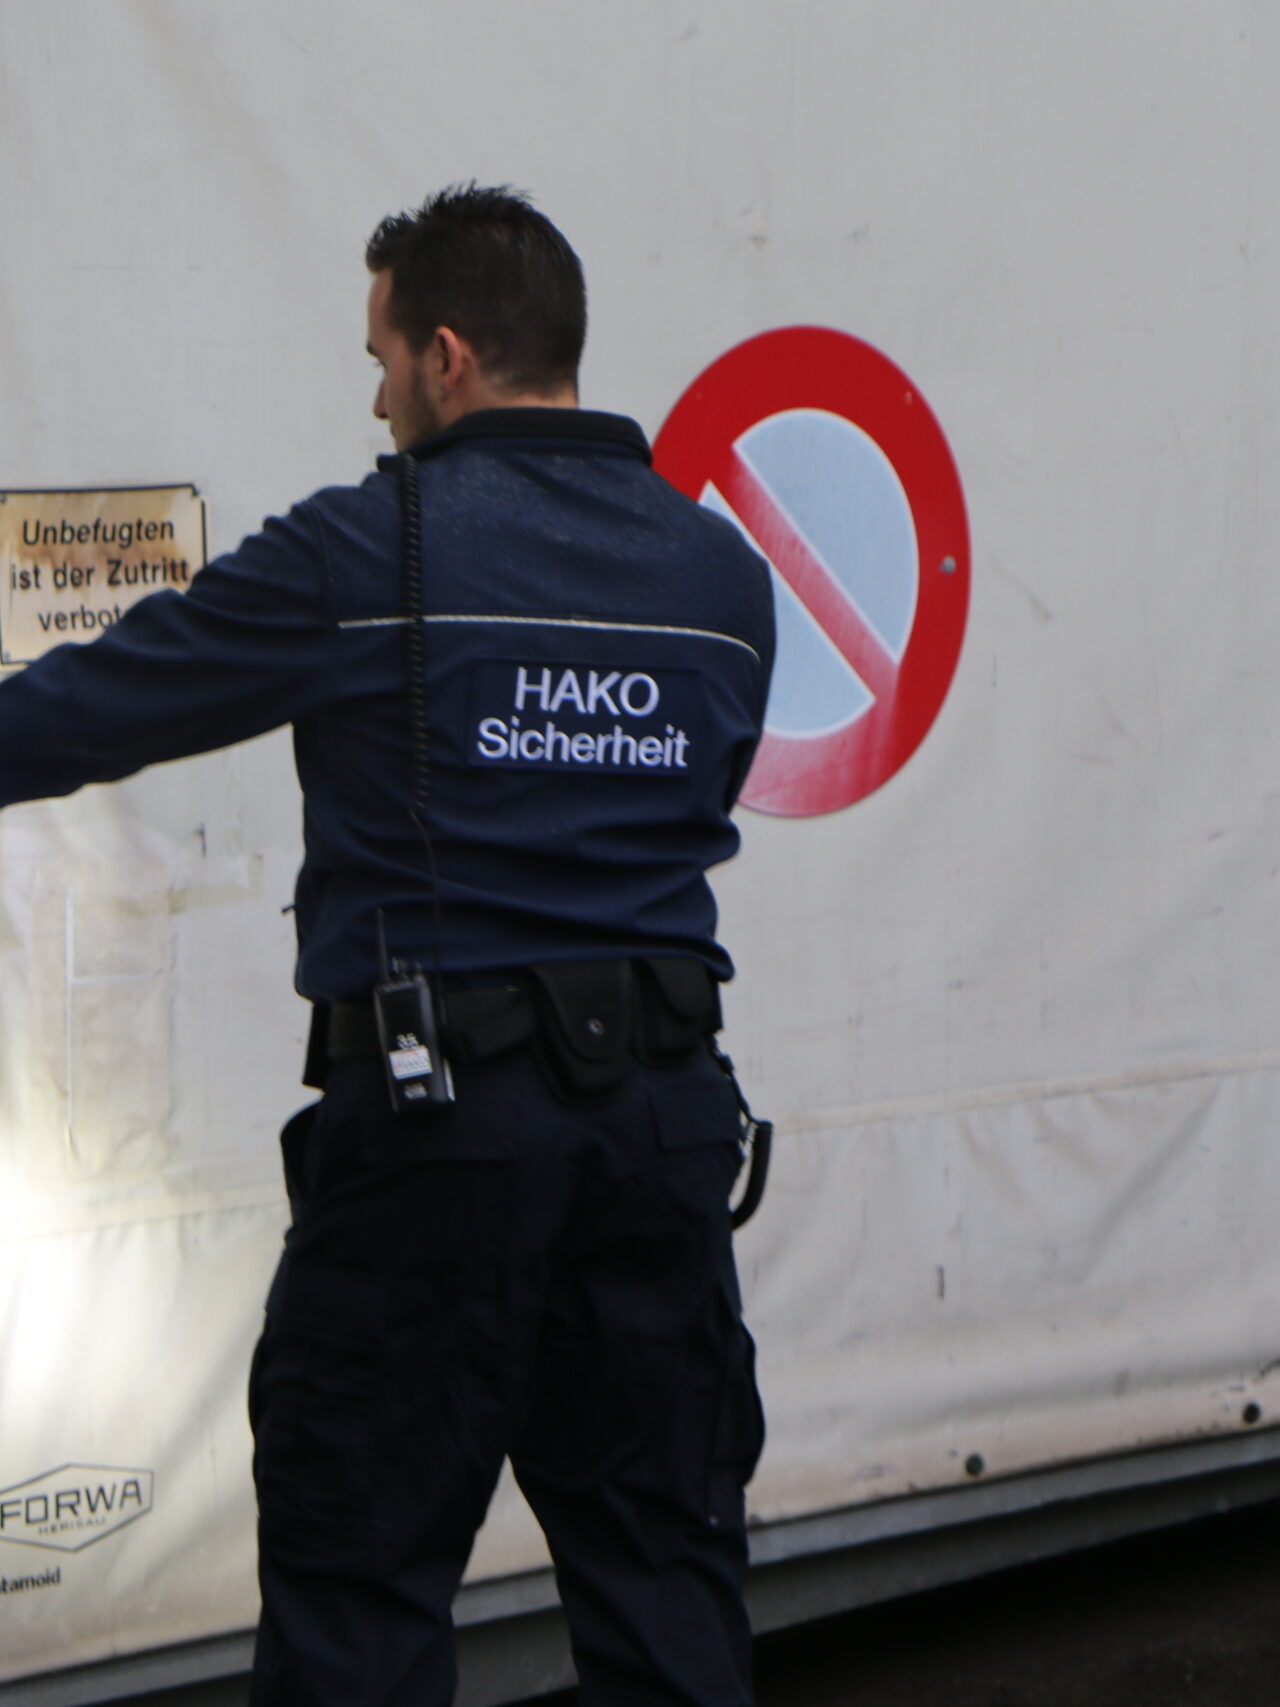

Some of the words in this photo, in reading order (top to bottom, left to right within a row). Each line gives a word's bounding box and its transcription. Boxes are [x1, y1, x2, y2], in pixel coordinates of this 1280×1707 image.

[23, 518, 174, 548] Unbefugten
[11, 564, 41, 589] ist
[53, 562, 95, 588] der
[107, 558, 189, 586] Zutritt
[38, 604, 121, 631] verbot
[514, 666, 660, 717] HAKO
[477, 715, 690, 768] Sicherheit
[0, 1479, 142, 1530] FORWA
